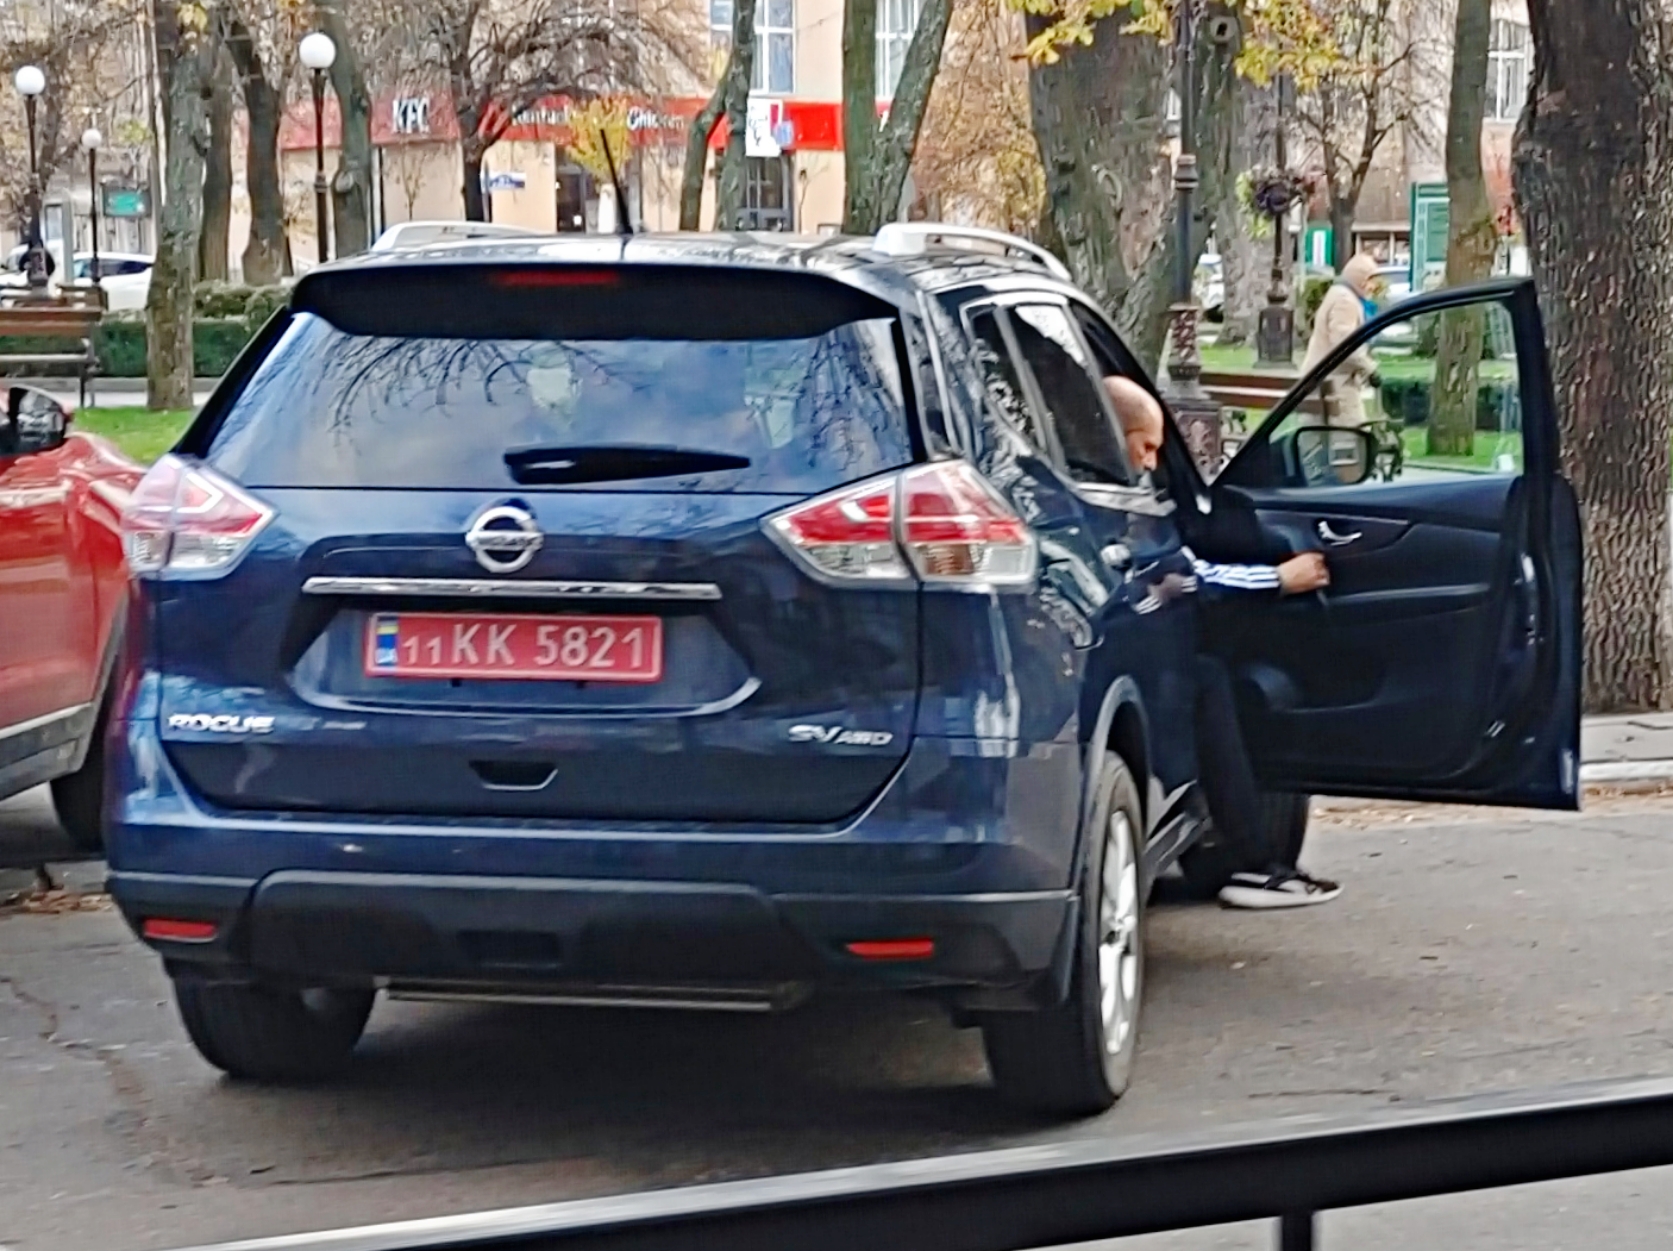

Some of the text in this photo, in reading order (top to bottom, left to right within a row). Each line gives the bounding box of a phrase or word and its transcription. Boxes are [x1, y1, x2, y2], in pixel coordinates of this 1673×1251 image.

[392, 97, 430, 134] KFC
[534, 625, 643, 669] 5821
[168, 713, 275, 734] ROGUE
